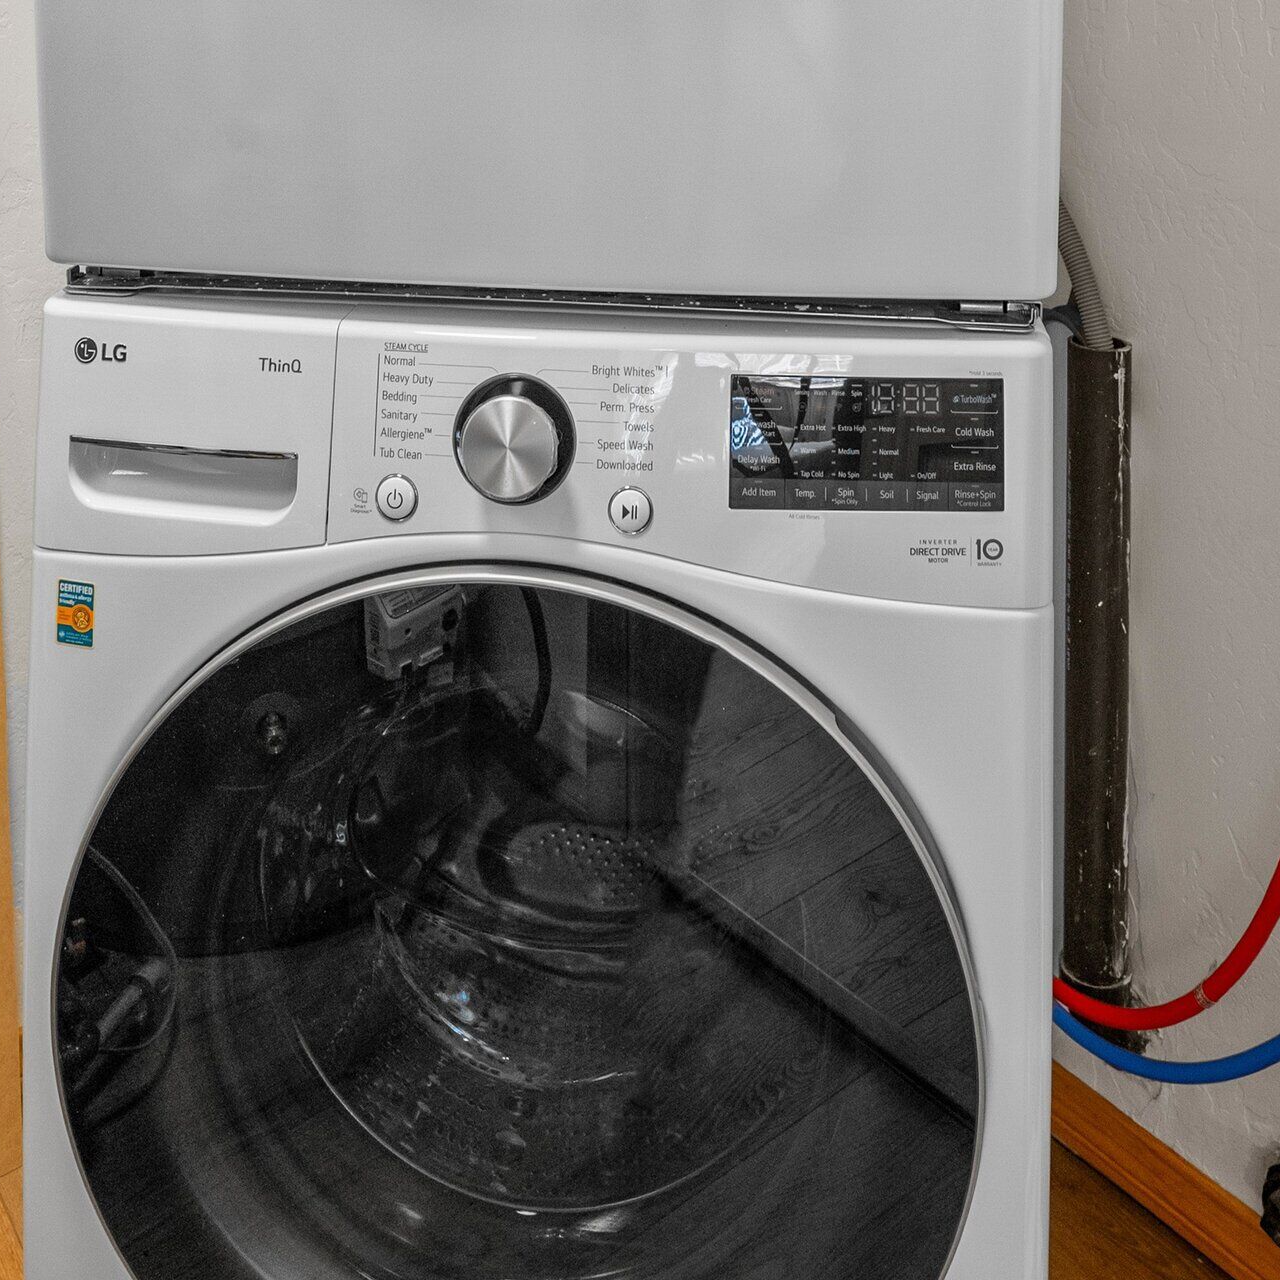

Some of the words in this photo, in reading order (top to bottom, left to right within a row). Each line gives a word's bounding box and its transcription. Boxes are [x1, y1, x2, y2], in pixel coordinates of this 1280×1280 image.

[384, 342, 404, 351] STEAM
[404, 343, 428, 352] CYCLE
[101, 344, 127, 362] LG
[259, 357, 302, 373] ThinQ
[384, 355, 416, 367] Normal
[592, 365, 621, 378] Bright
[383, 372, 410, 385] Heavy
[412, 373, 434, 387] Duty
[612, 383, 655, 395] Delicates
[382, 390, 418, 404] Bedding
[600, 402, 626, 413] Perm.
[629, 403, 655, 414] Press
[381, 408, 418, 423] Sanitary
[623, 421, 654, 433] Towels
[800, 424, 815, 432] Extra
[853, 425, 867, 433] High
[878, 425, 896, 433] Heavy
[955, 427, 973, 437] Cold
[974, 428, 995, 437] Wash
[597, 439, 625, 452] Speed
[629, 440, 654, 451] Wash
[380, 447, 395, 458] Tub
[397, 448, 423, 460] Clean
[879, 448, 899, 456] Normal
[737, 455, 758, 464] Delay
[760, 455, 780, 464] Wash
[596, 459, 654, 472] Downloaded
[953, 462, 974, 471] Extra
[976, 462, 997, 471] Rinse
[800, 471, 811, 479] Tap
[847, 471, 860, 479] Spin
[917, 471, 937, 479] On/Off
[741, 487, 758, 496] Add
[759, 488, 777, 497] Item
[794, 488, 816, 499] Temp.
[838, 487, 855, 498] Spin
[880, 490, 894, 499] Soil
[916, 490, 939, 501] Signal
[954, 489, 996, 500] Rinse+Spin
[846, 498, 858, 506] Only
[910, 547, 939, 556] DIRECT
[942, 547, 967, 556] DRIVE
[976, 538, 1003, 560] 10
[59, 583, 93, 595] CERTIFIED
